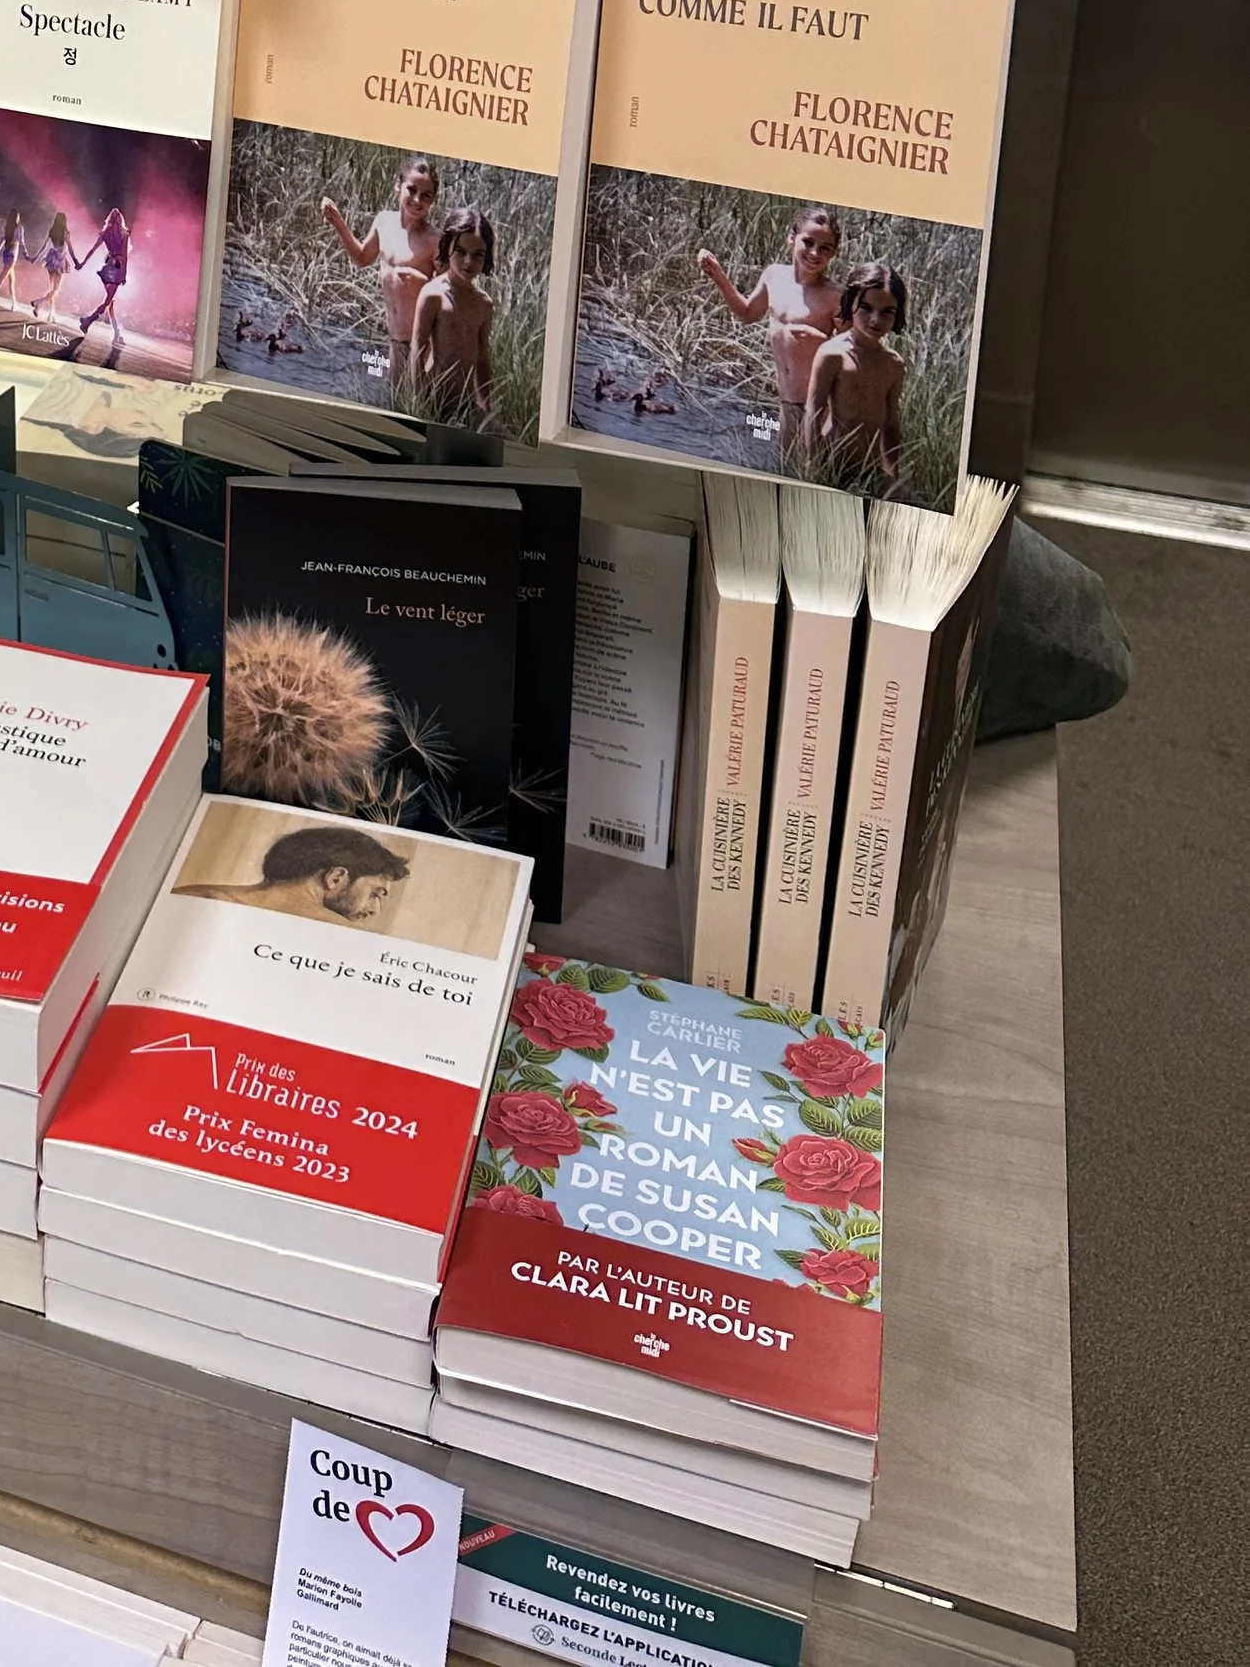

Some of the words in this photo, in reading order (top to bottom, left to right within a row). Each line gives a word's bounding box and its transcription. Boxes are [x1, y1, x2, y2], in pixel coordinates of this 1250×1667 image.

[19, 3, 125, 41] Spectacle
[758, 0, 784, 29] IL
[790, 7, 869, 41] FAUT
[63, 47, 77, 66] 정
[794, 92, 953, 141] FLORENCE
[750, 120, 949, 175] CHATAIGNIER
[301, 560, 400, 579] JEAN-FRANÇOIS
[403, 568, 486, 586] BEAUCHEMIN
[365, 596, 390, 619] Le
[394, 603, 436, 622] vent
[441, 602, 486, 628] léger
[731, 656, 749, 729] PATURAUD
[24, 704, 88, 734] Divry
[725, 731, 743, 787] VALÉRIE
[254, 944, 283, 962] Ce
[289, 955, 330, 977] que
[335, 961, 357, 980] je
[362, 968, 401, 988] sais
[408, 976, 435, 996] de
[443, 986, 473, 1006] toi
[380, 952, 408, 970] Éric
[413, 959, 477, 985] Chacour
[630, 1040, 676, 1070] LA
[690, 1056, 752, 1087] VIE
[226, 1068, 341, 1120] Libraires
[352, 1107, 418, 1140] 2024
[590, 1062, 701, 1107] N'EST
[710, 1094, 785, 1129] PAS
[653, 1113, 711, 1146] UN
[599, 1134, 759, 1195] ROMAN
[570, 1162, 626, 1197] DE
[635, 1179, 780, 1237] SUSAN
[578, 1202, 763, 1269] COOPER
[310, 1449, 393, 1496] Coup
[313, 1491, 350, 1522] de
[546, 1554, 628, 1593] Revendez
[632, 1581, 660, 1604] vos
[665, 1588, 716, 1622] livres
[574, 1587, 666, 1628] facilement
